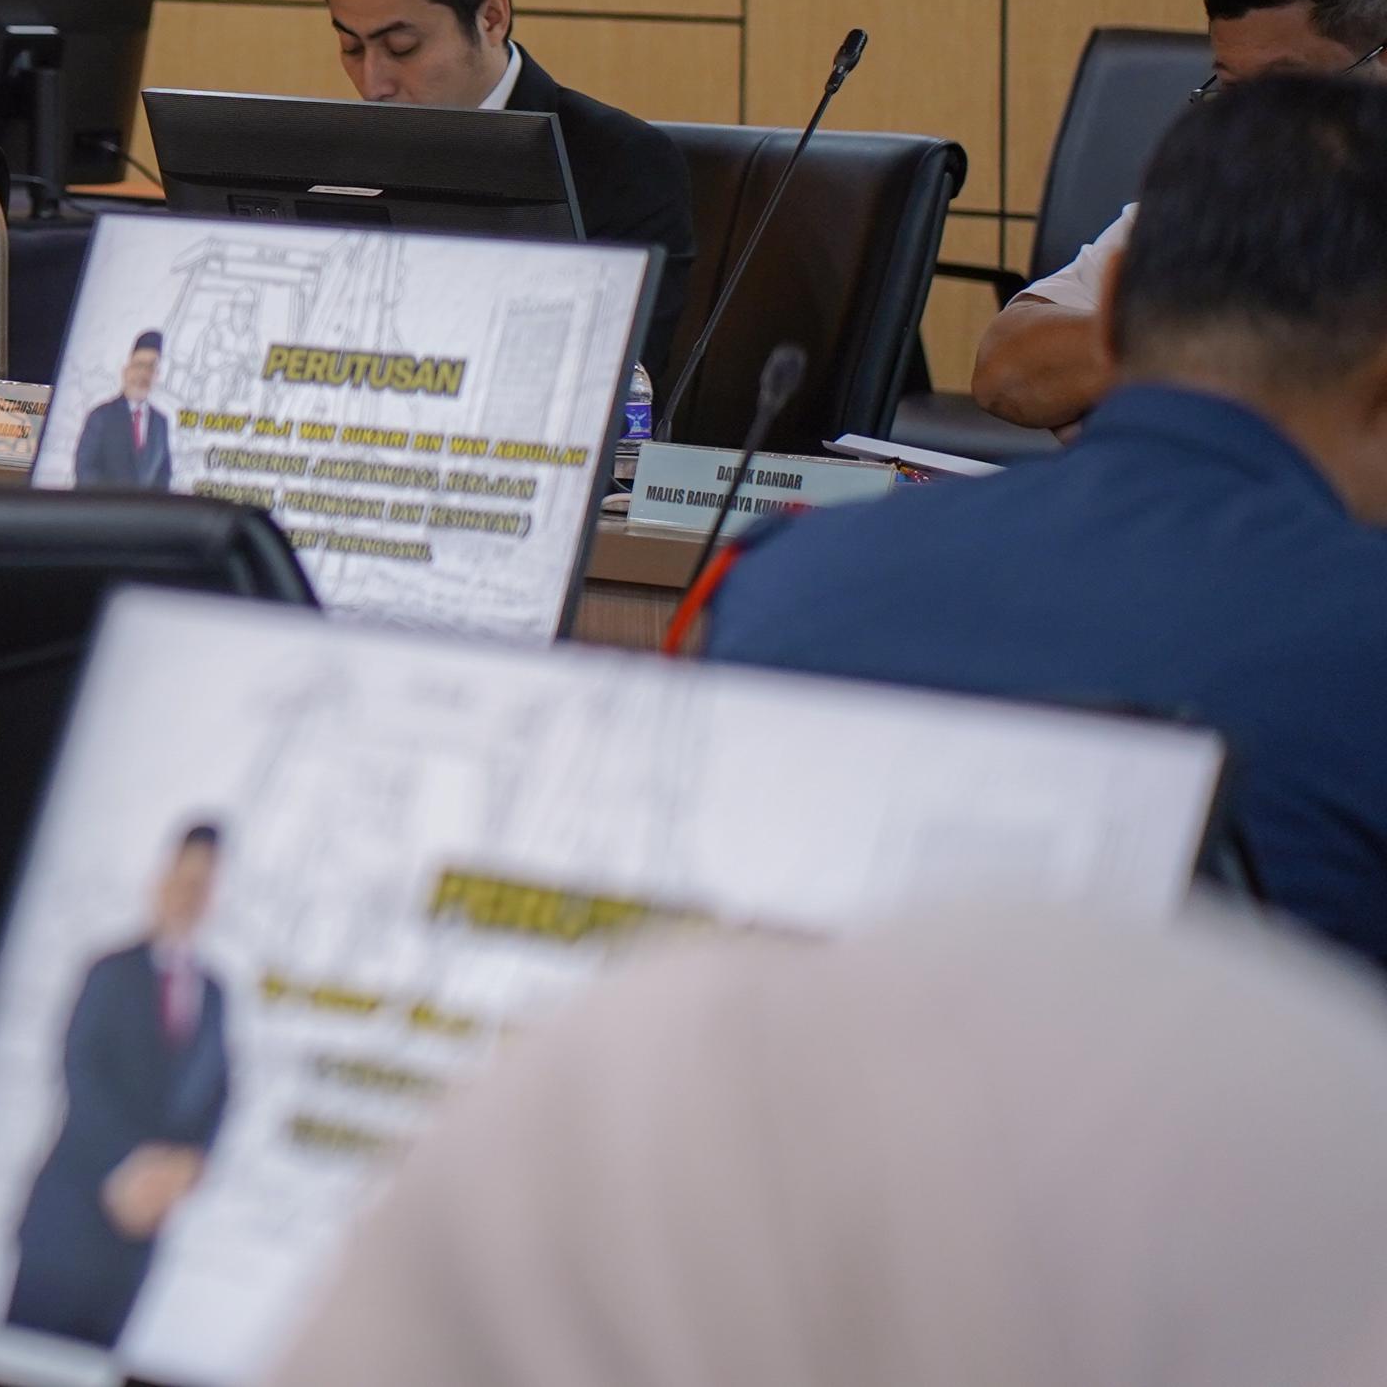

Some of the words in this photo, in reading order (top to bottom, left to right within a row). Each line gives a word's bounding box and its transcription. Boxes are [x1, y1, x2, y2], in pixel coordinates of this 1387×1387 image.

[263, 344, 467, 399] PERUTUSAN
[253, 416, 294, 438] HAJI
[298, 420, 337, 442] WAN
[411, 431, 444, 453] BIN
[448, 435, 490, 457] WAN
[491, 439, 589, 467] ABDULLAH
[441, 469, 538, 501] KERAJAAN
[716, 465, 755, 485] DATK
[755, 469, 803, 490] BANDAR
[645, 485, 685, 504] MAJLIS
[686, 491, 753, 512] BANDAAYA
[386, 500, 426, 525] DAN
[426, 504, 521, 534] KESIHATAN
